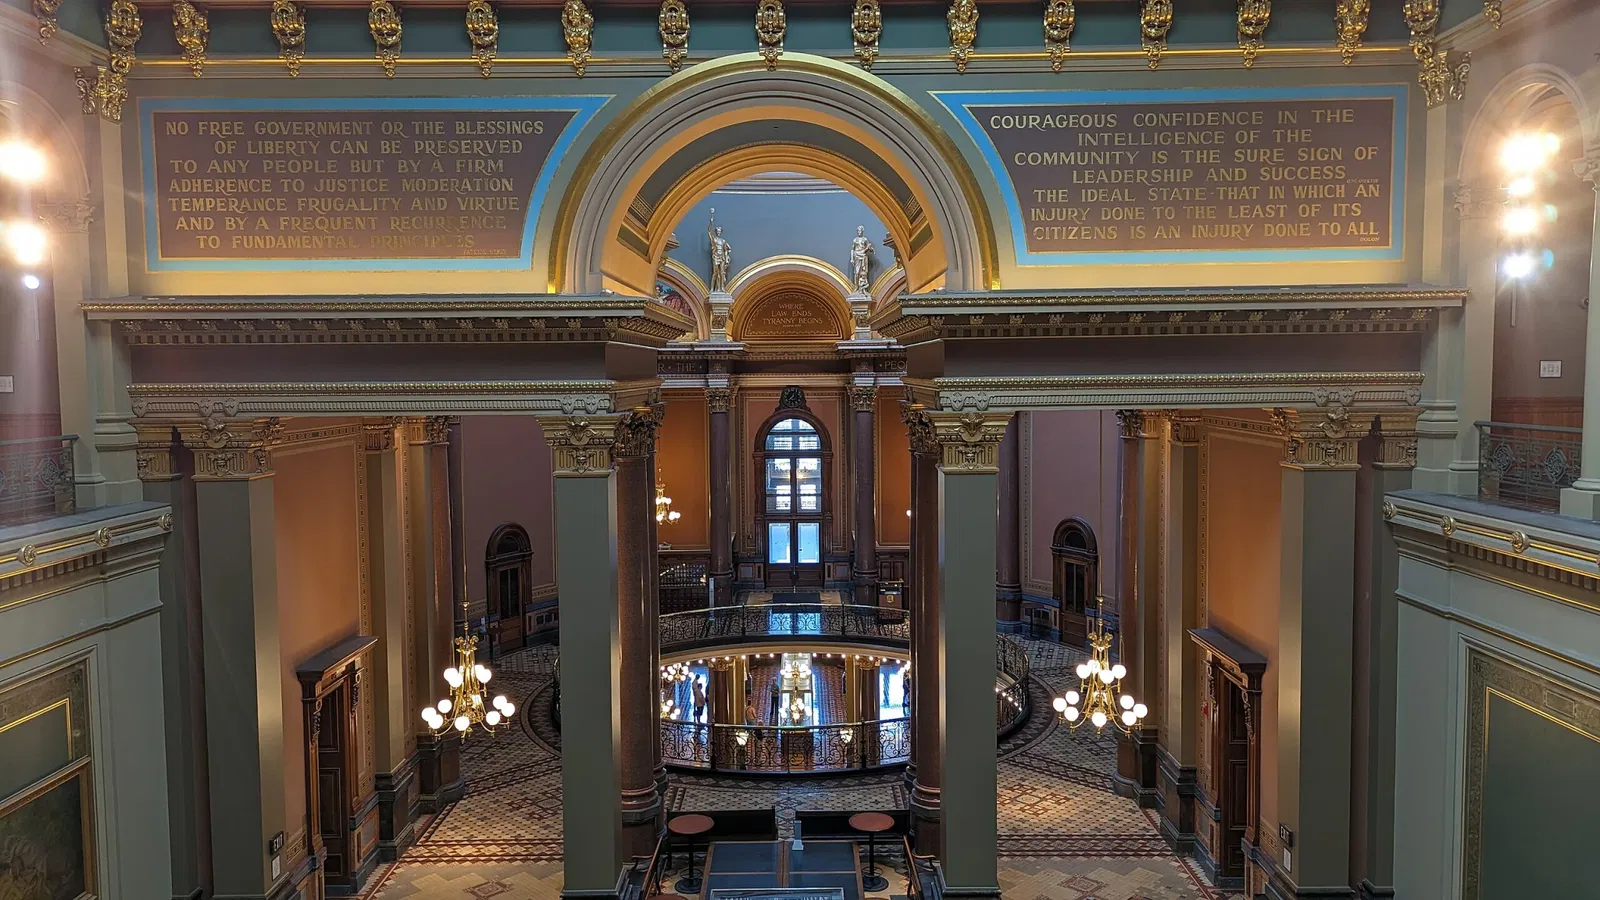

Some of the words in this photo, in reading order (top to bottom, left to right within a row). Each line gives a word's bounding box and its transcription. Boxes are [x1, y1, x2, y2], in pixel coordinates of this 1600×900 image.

[990, 113, 1118, 131] COURAGEOUS
[1133, 111, 1264, 127] CONFIDENCE
[1277, 110, 1298, 124] IN
[1311, 109, 1355, 123] THE
[165, 121, 189, 135] NO
[198, 121, 245, 138] FREE
[254, 121, 373, 138] GOVERNMENT
[381, 121, 411, 138] OR
[411, 121, 445, 135] THE
[455, 120, 544, 135] BLESSINGS
[1078, 131, 1225, 146] INTELLIGENCE
[1235, 130, 1261, 144] OF
[1272, 129, 1313, 143] THE
[214, 140, 237, 154] OF
[247, 140, 321, 156] LIBERTY
[330, 140, 368, 154] CAN
[380, 140, 402, 154] BE
[414, 139, 523, 157] PRESERVED
[1014, 151, 1139, 166] COMMUNITY
[1151, 150, 1168, 164] IS
[1181, 149, 1221, 163] THE
[1234, 148, 1285, 165] SURE
[1298, 147, 1343, 162] SIGN
[1354, 146, 1379, 161] OF
[169, 159, 198, 174] TO
[206, 159, 250, 173] ANY
[262, 159, 338, 173] PEOPLE
[350, 159, 385, 173] BUT
[398, 159, 422, 173] BY
[430, 159, 444, 173] A
[456, 159, 504, 176] FIRM
[1072, 168, 1194, 186] LEADERSHIP
[1205, 167, 1247, 182] AND
[1260, 166, 1346, 181] SUCCESS
[169, 178, 272, 195] ADHERENCE
[280, 178, 305, 193] TO
[314, 178, 389, 193] JUSTICE
[402, 178, 514, 194] MODERATION
[1033, 189, 1069, 203] THE
[1081, 188, 1136, 202] IDEAL
[1269, 185, 1285, 199] IN
[1293, 184, 1346, 199] WHICH
[1354, 184, 1380, 198] AN
[168, 197, 287, 214] TEMPERANCE
[297, 197, 402, 214] FRUGALITY
[410, 197, 448, 211] AND
[457, 197, 520, 213] VIRTUE
[1030, 207, 1091, 225] INJURY
[1101, 207, 1145, 221] DONE
[1152, 206, 1175, 220] TO
[1183, 205, 1217, 219] THE
[1228, 204, 1288, 219] LEAST
[1298, 203, 1322, 218] OF
[1333, 203, 1362, 217] ITS
[175, 216, 215, 231] AND
[225, 216, 249, 230] BY
[255, 216, 270, 230] A
[279, 216, 378, 232] FREQUENT
[390, 216, 507, 233] RECURRENCE
[1033, 225, 1118, 240] CITIZENS
[1130, 225, 1146, 239] IS
[1154, 225, 1181, 239] AN
[1191, 223, 1254, 241] INJURY
[1264, 223, 1311, 237] DONE
[1318, 222, 1341, 236] TO
[1347, 221, 1380, 236] ALL
[195, 235, 221, 249] TO
[231, 235, 359, 249] FUNDAMENTAL
[762, 317, 797, 325] TYRANNY
[676, 362, 697, 372] THE
